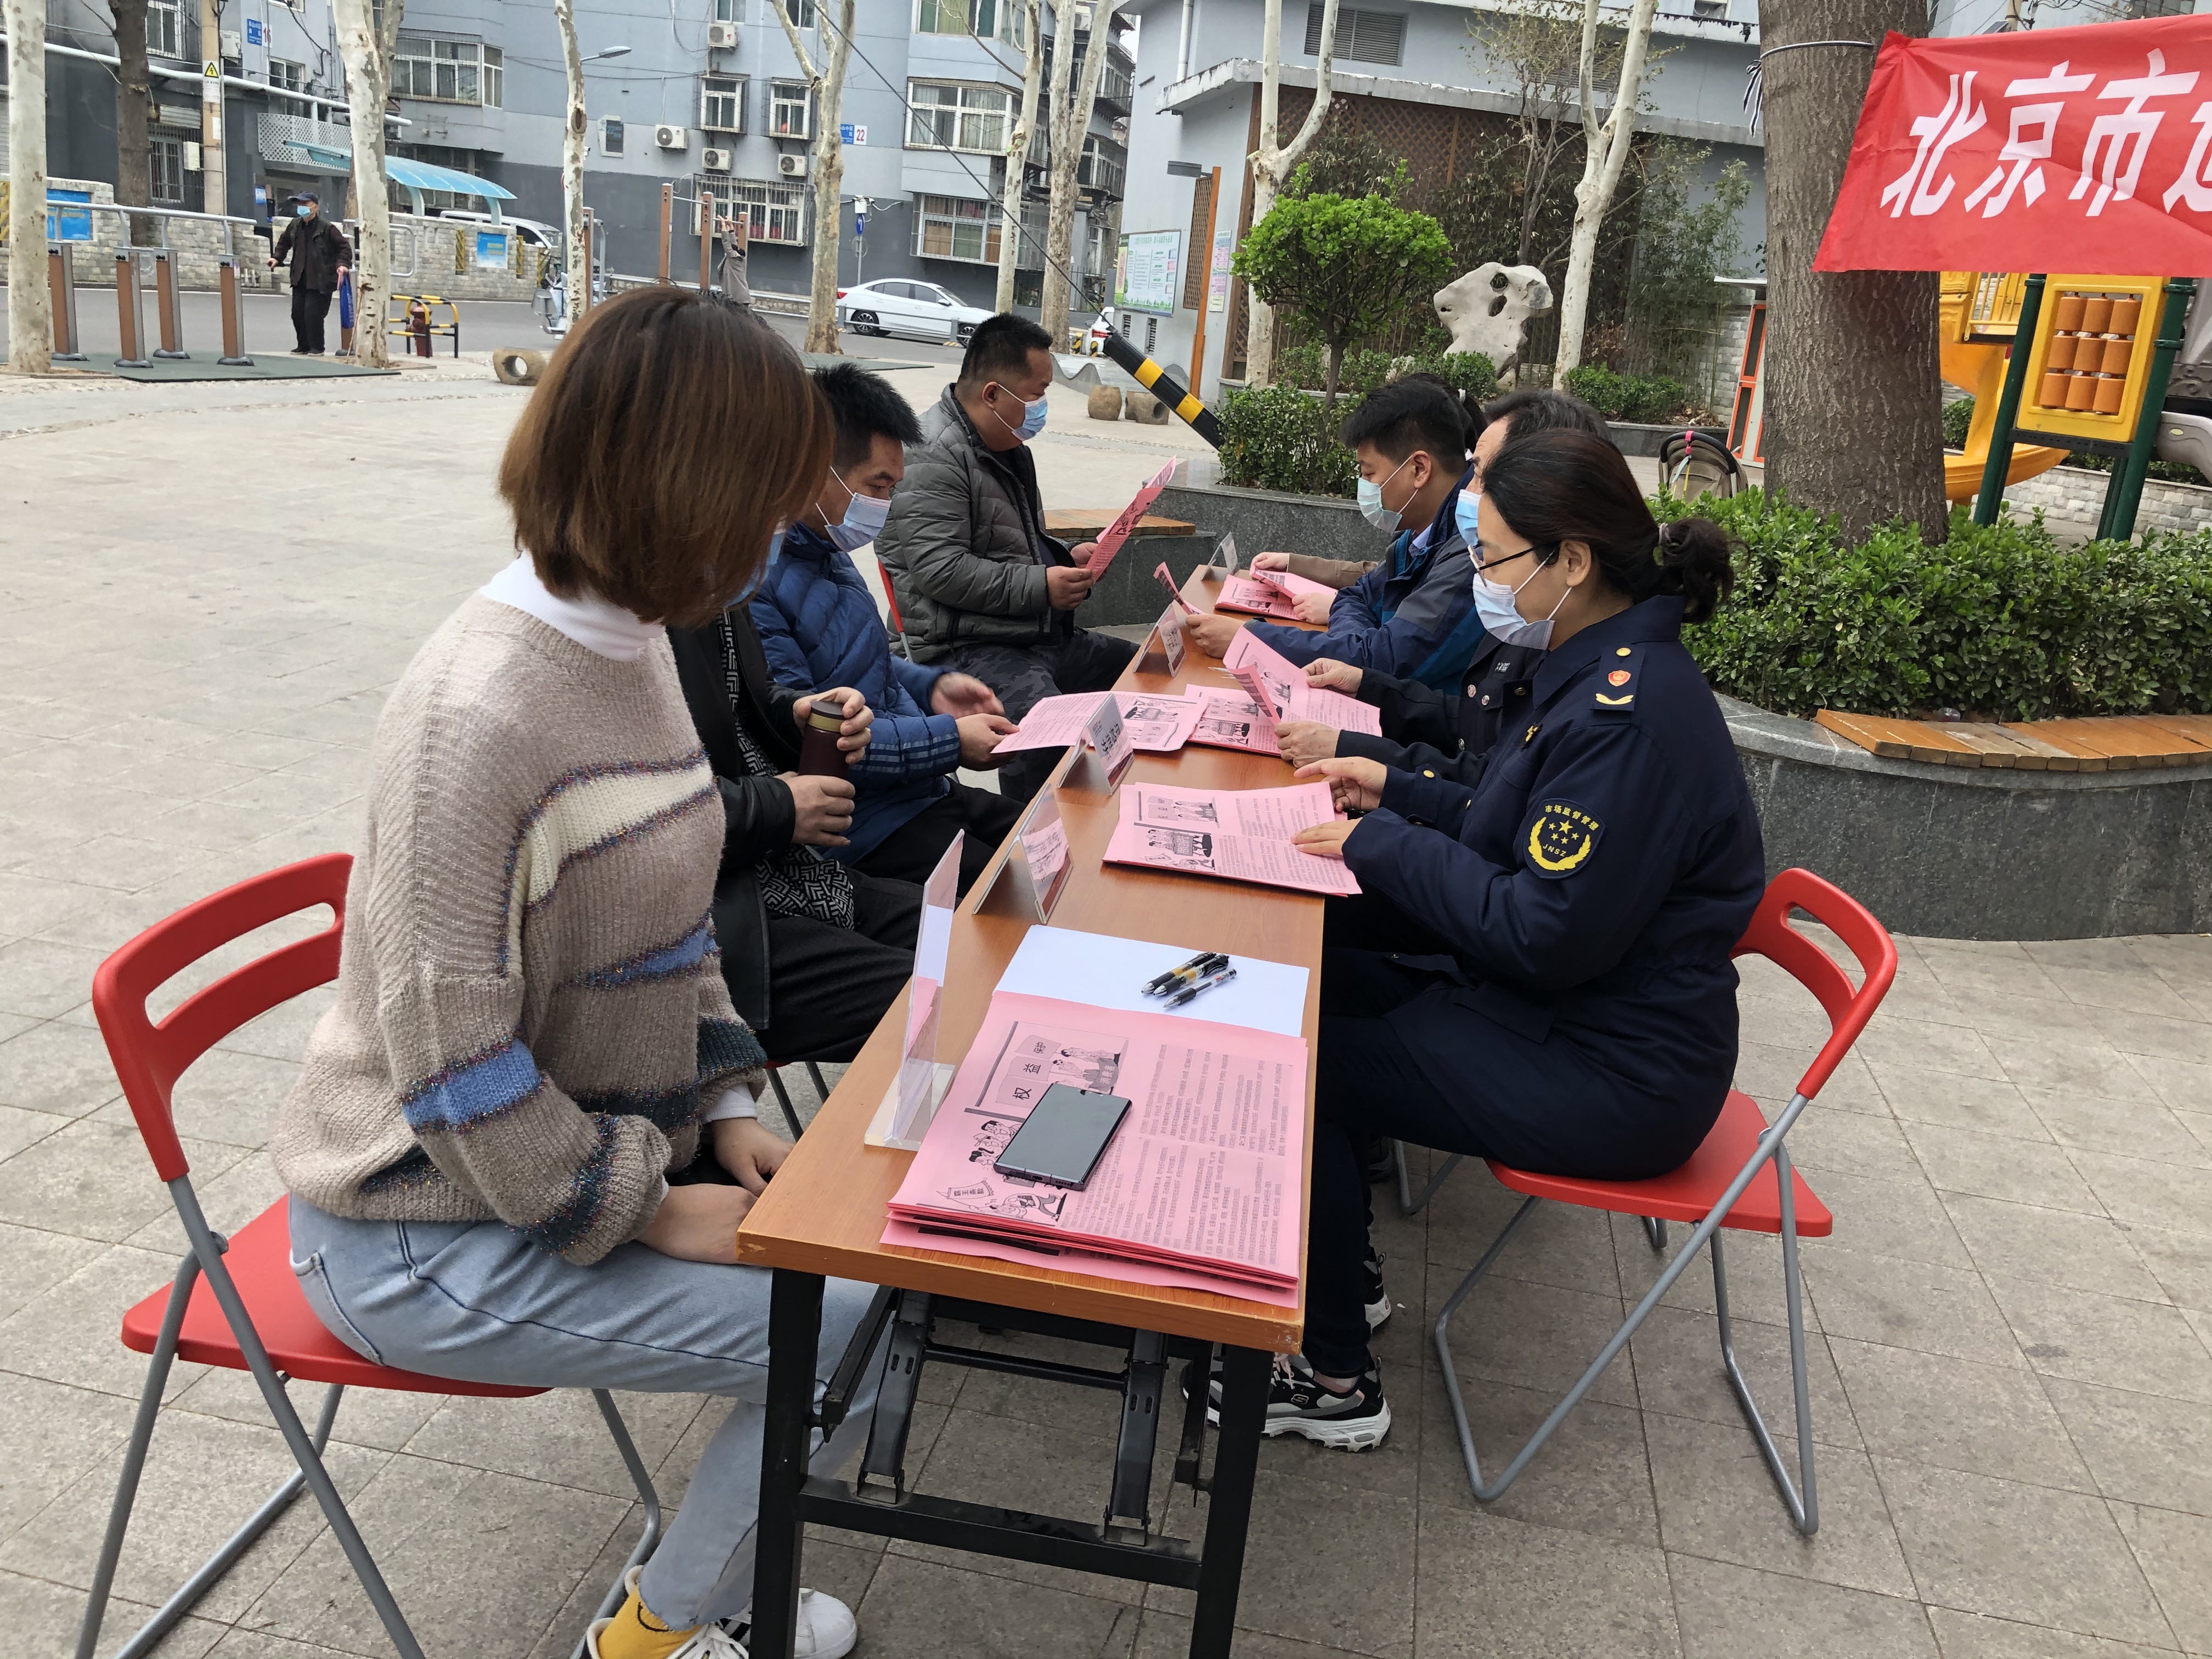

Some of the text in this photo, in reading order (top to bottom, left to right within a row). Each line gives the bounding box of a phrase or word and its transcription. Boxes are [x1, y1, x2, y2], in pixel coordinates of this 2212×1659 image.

[856, 128, 865, 142] 22
[1545, 804, 1599, 831] 市场监督管理
[1542, 844, 1567, 857] JNSZ
[1032, 1041, 1046, 1054] 保护
[1023, 1063, 1042, 1074] 益
[1012, 1087, 1032, 1100] 权
